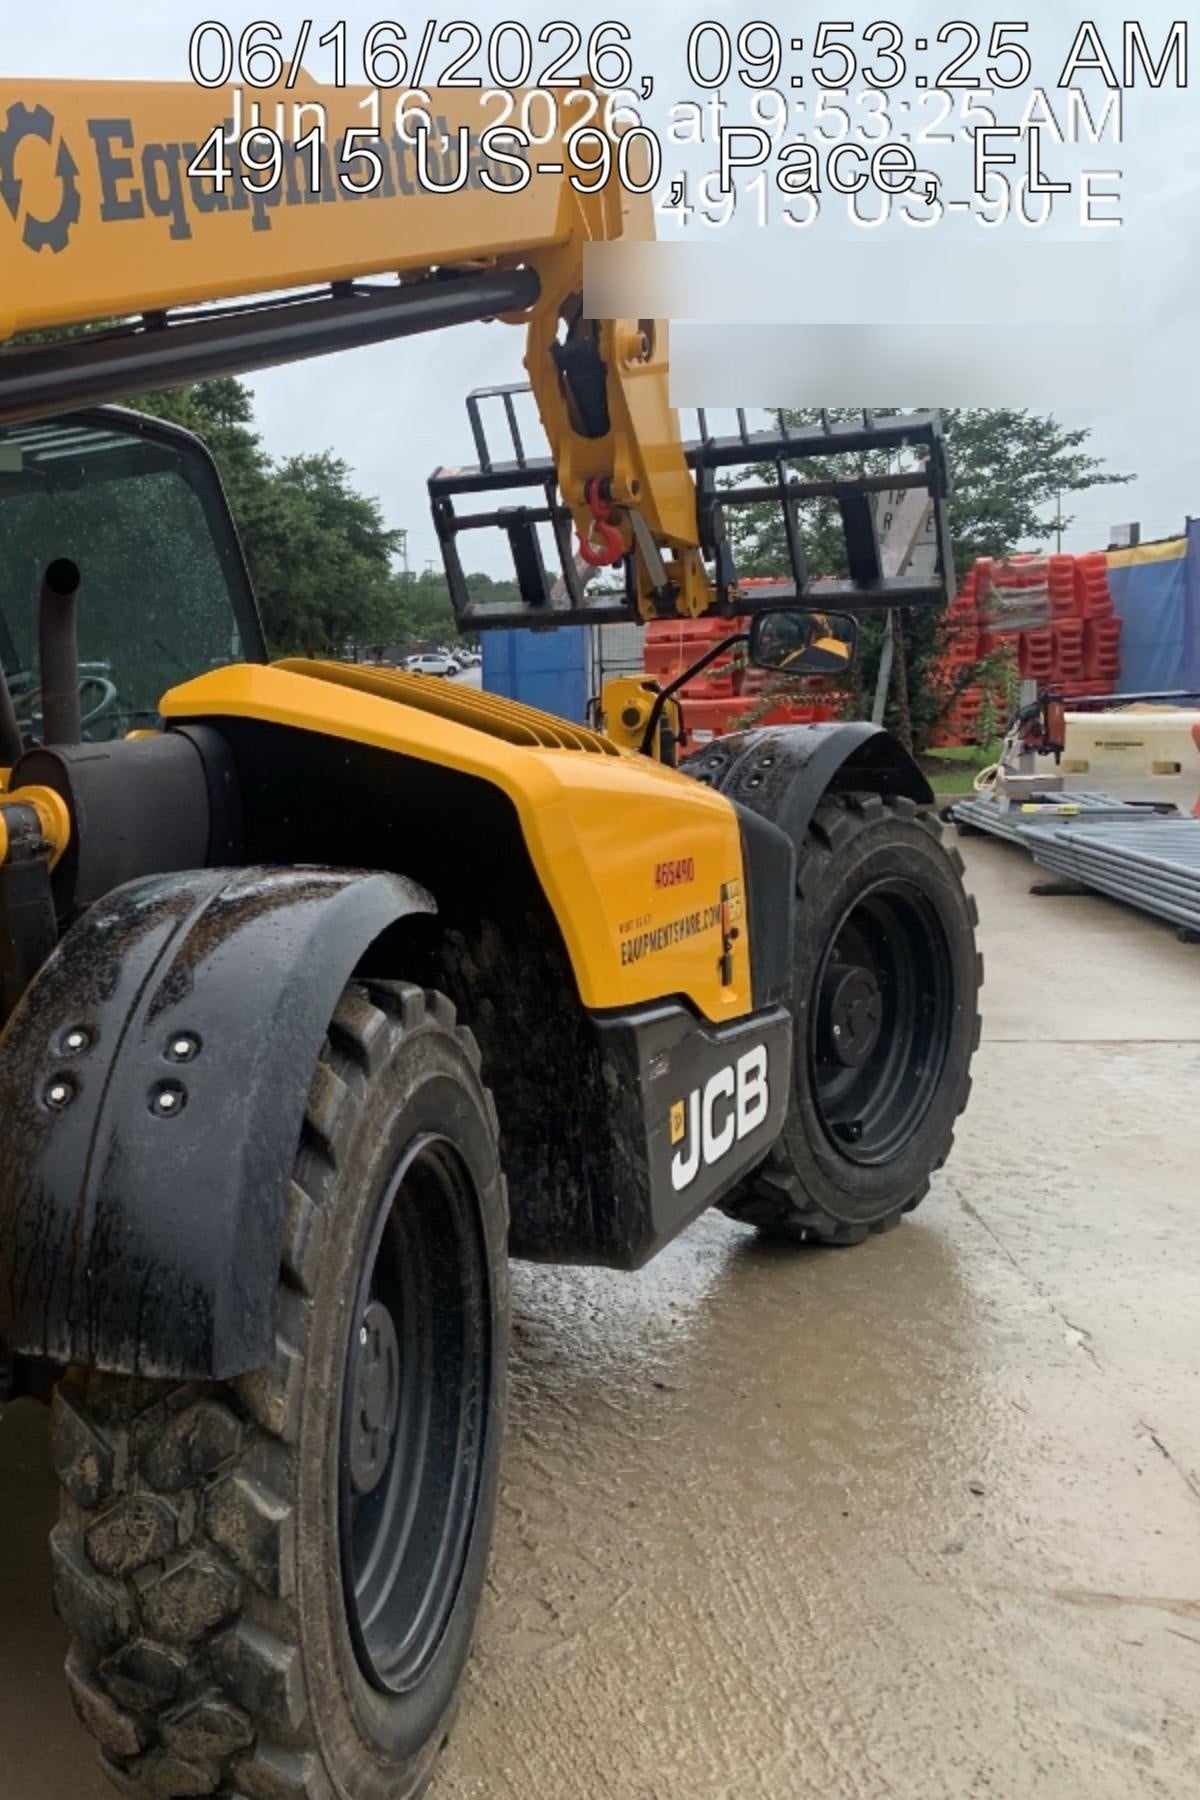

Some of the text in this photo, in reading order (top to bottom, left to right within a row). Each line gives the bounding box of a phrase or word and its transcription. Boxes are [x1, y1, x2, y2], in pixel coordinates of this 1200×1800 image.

[655, 857, 695, 889] 465490
[620, 903, 722, 967] EQUIPMENTSHARE.COM
[670, 1043, 768, 1192] JCB
